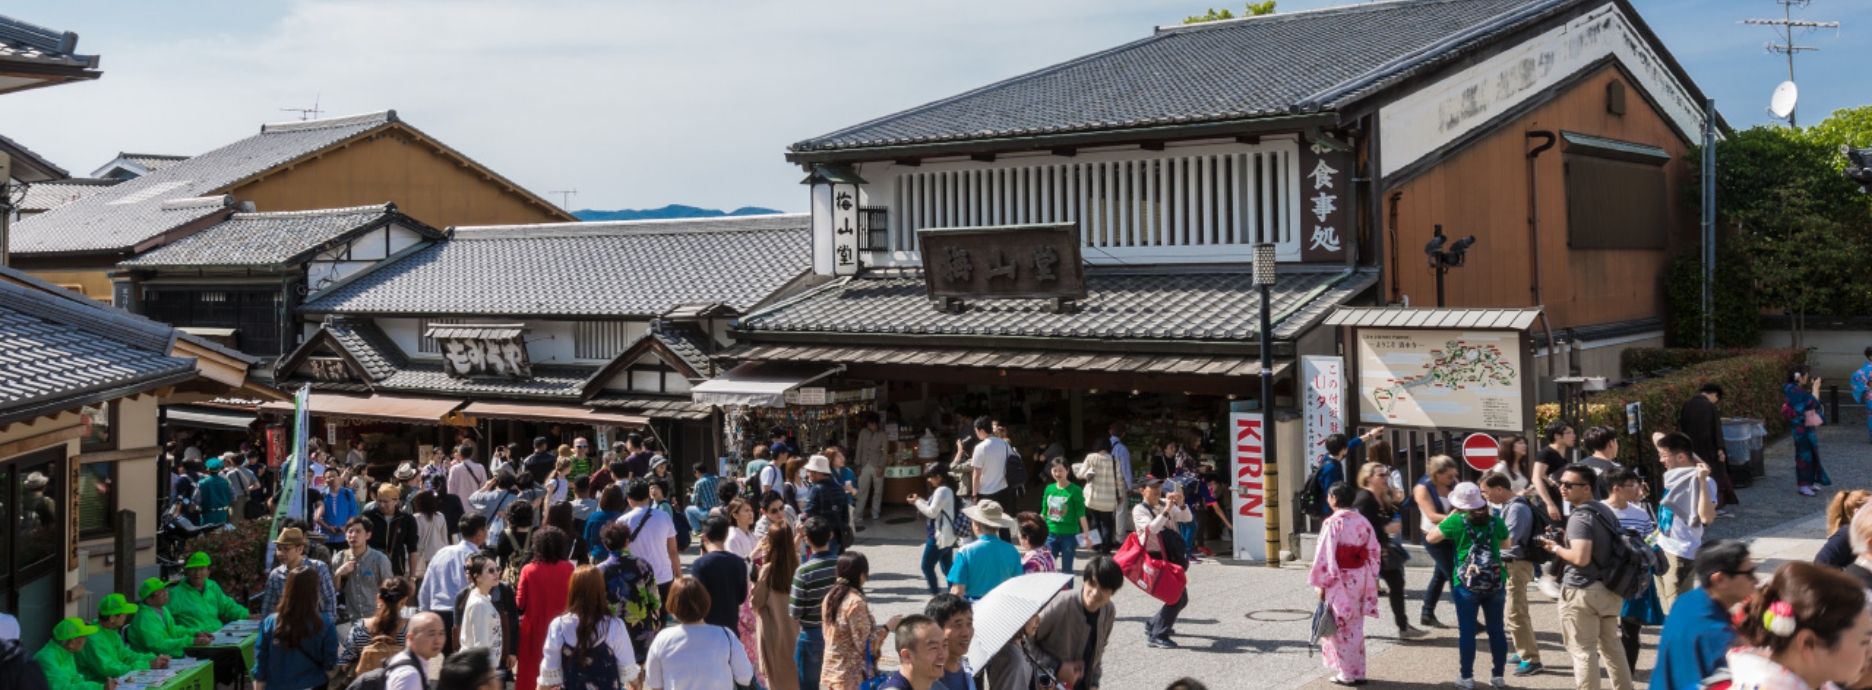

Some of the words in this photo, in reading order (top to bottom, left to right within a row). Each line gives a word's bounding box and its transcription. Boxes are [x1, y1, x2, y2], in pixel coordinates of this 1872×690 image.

[836, 191, 855, 266] 梅山堂
[941, 244, 1059, 283] 梅山堂
[1237, 418, 1264, 518] KIRIN
